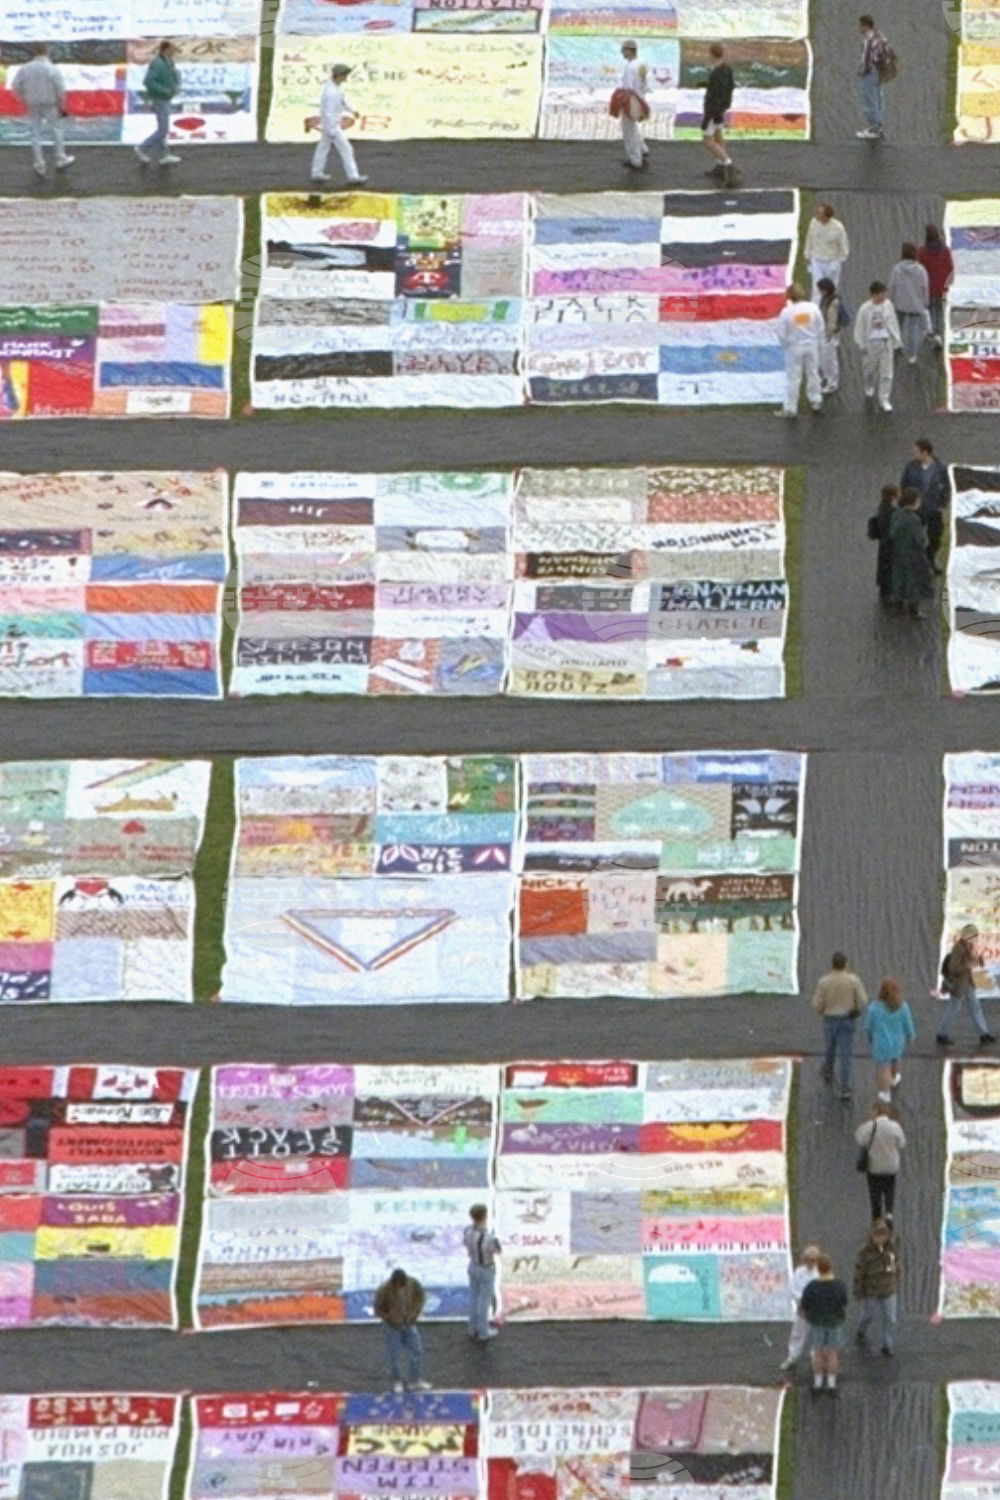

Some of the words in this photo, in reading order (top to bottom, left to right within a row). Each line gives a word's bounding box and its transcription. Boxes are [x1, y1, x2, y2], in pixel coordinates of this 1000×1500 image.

[521, 879, 585, 888] NICKY
[222, 1126, 338, 1141] FLACK
[223, 1141, 341, 1156] SCOTT
[493, 1424, 632, 1438] SCHNEIDER
[514, 1438, 609, 1451] BRUCE
